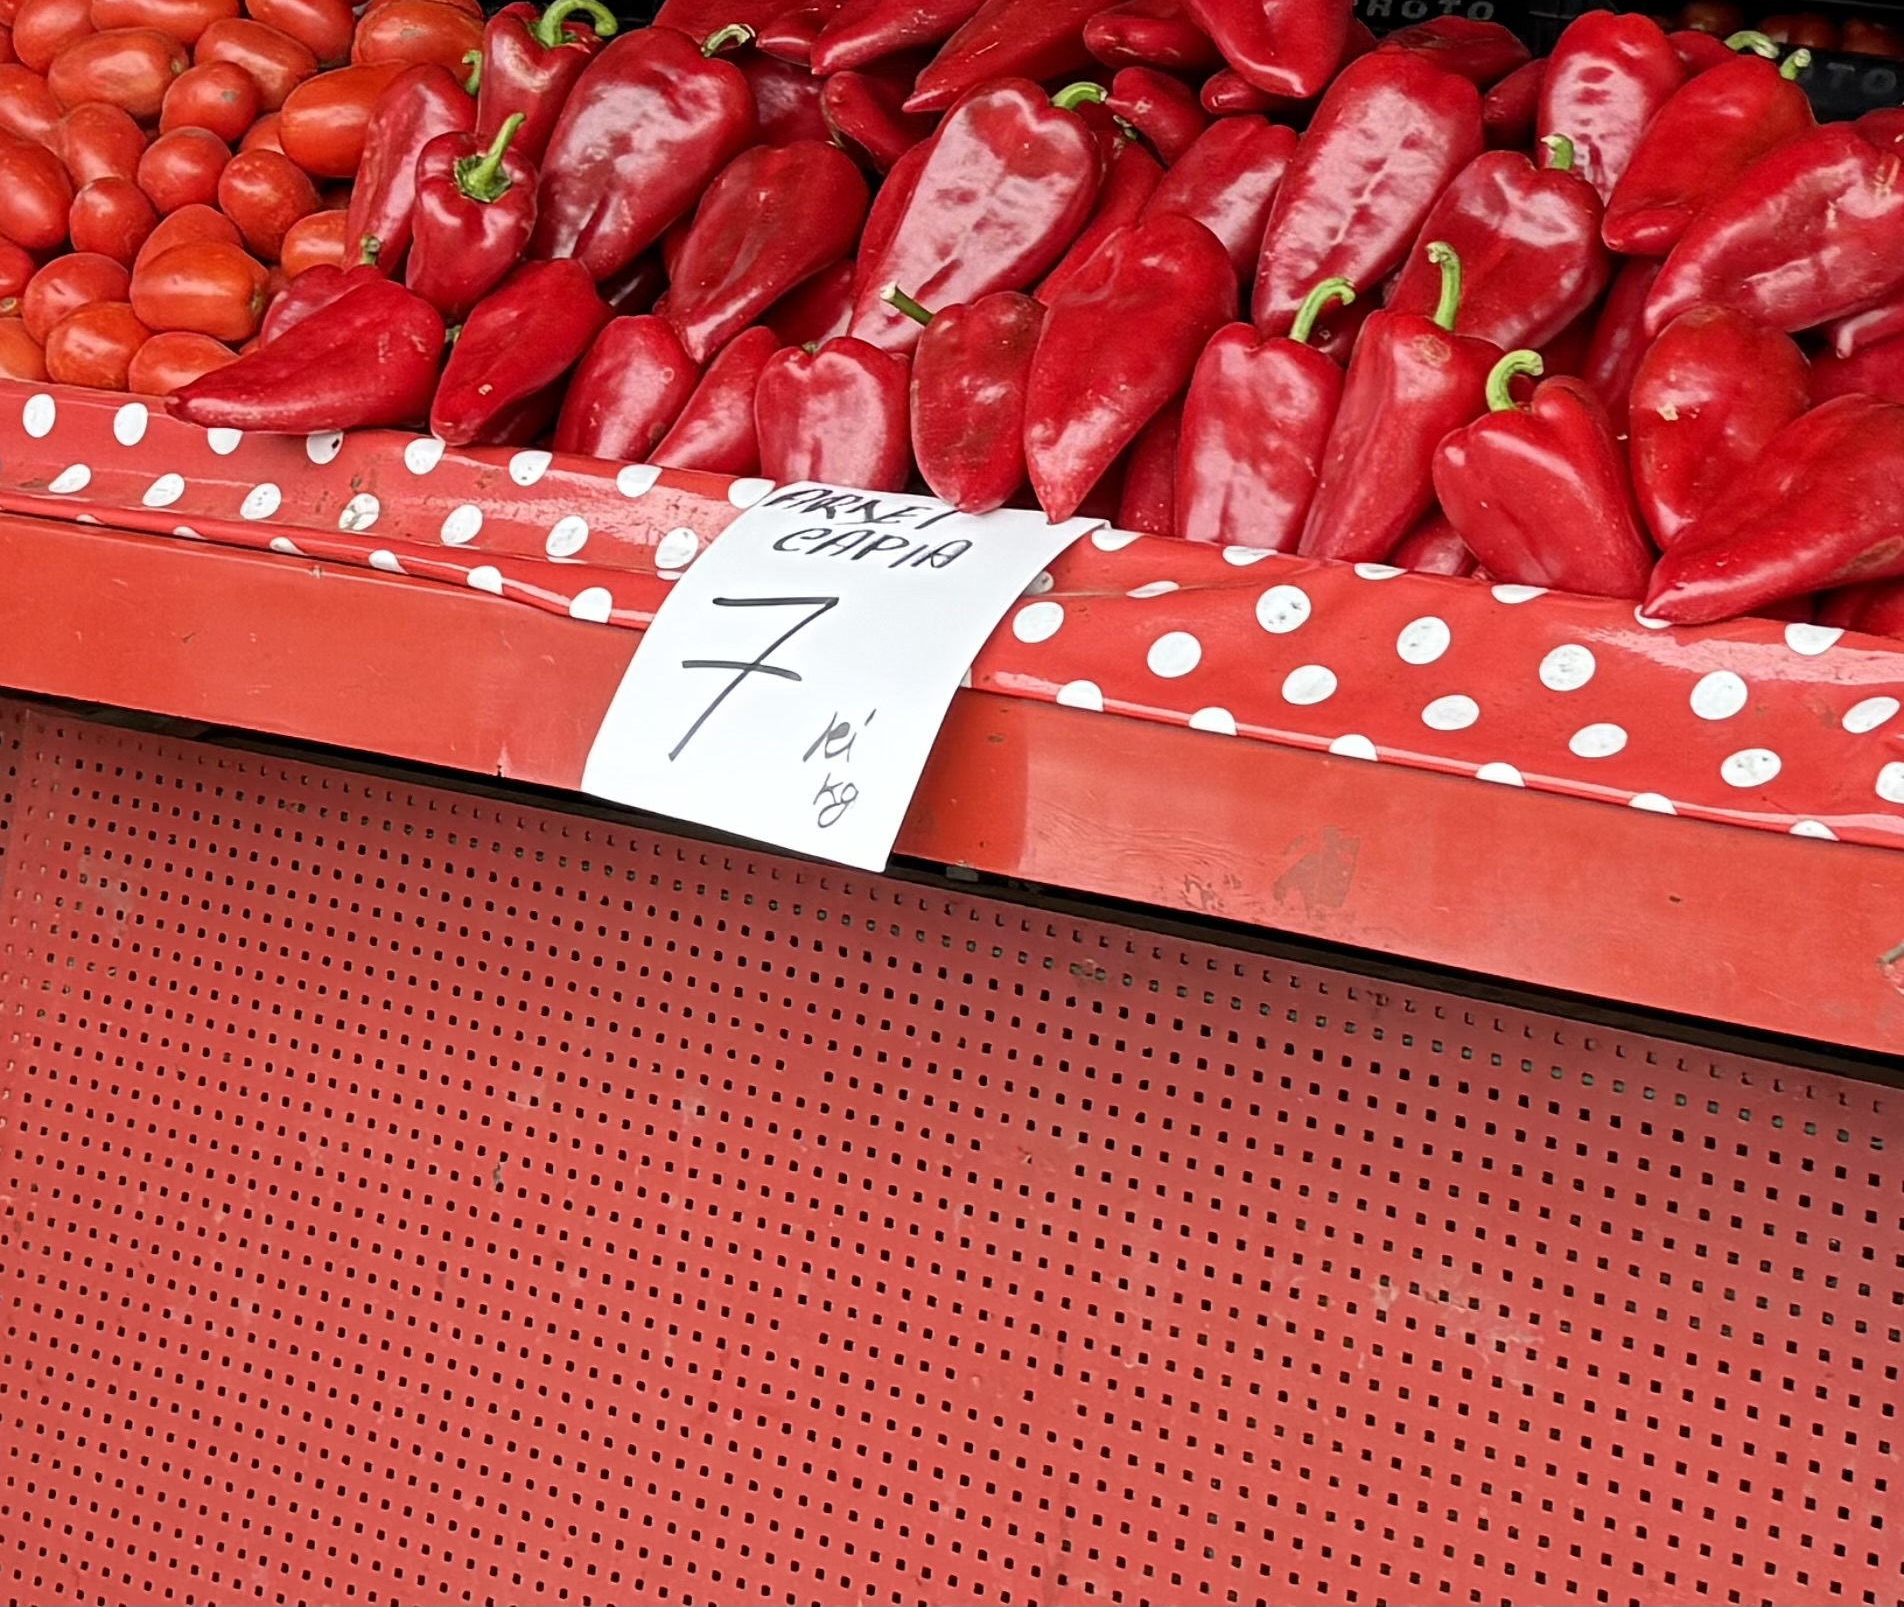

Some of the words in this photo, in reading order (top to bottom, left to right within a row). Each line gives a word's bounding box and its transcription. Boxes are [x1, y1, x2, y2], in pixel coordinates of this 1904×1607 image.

[772, 527, 974, 569] CAPIA
[668, 596, 840, 762] 7
[802, 707, 877, 763] lei
[813, 773, 860, 828] kg
